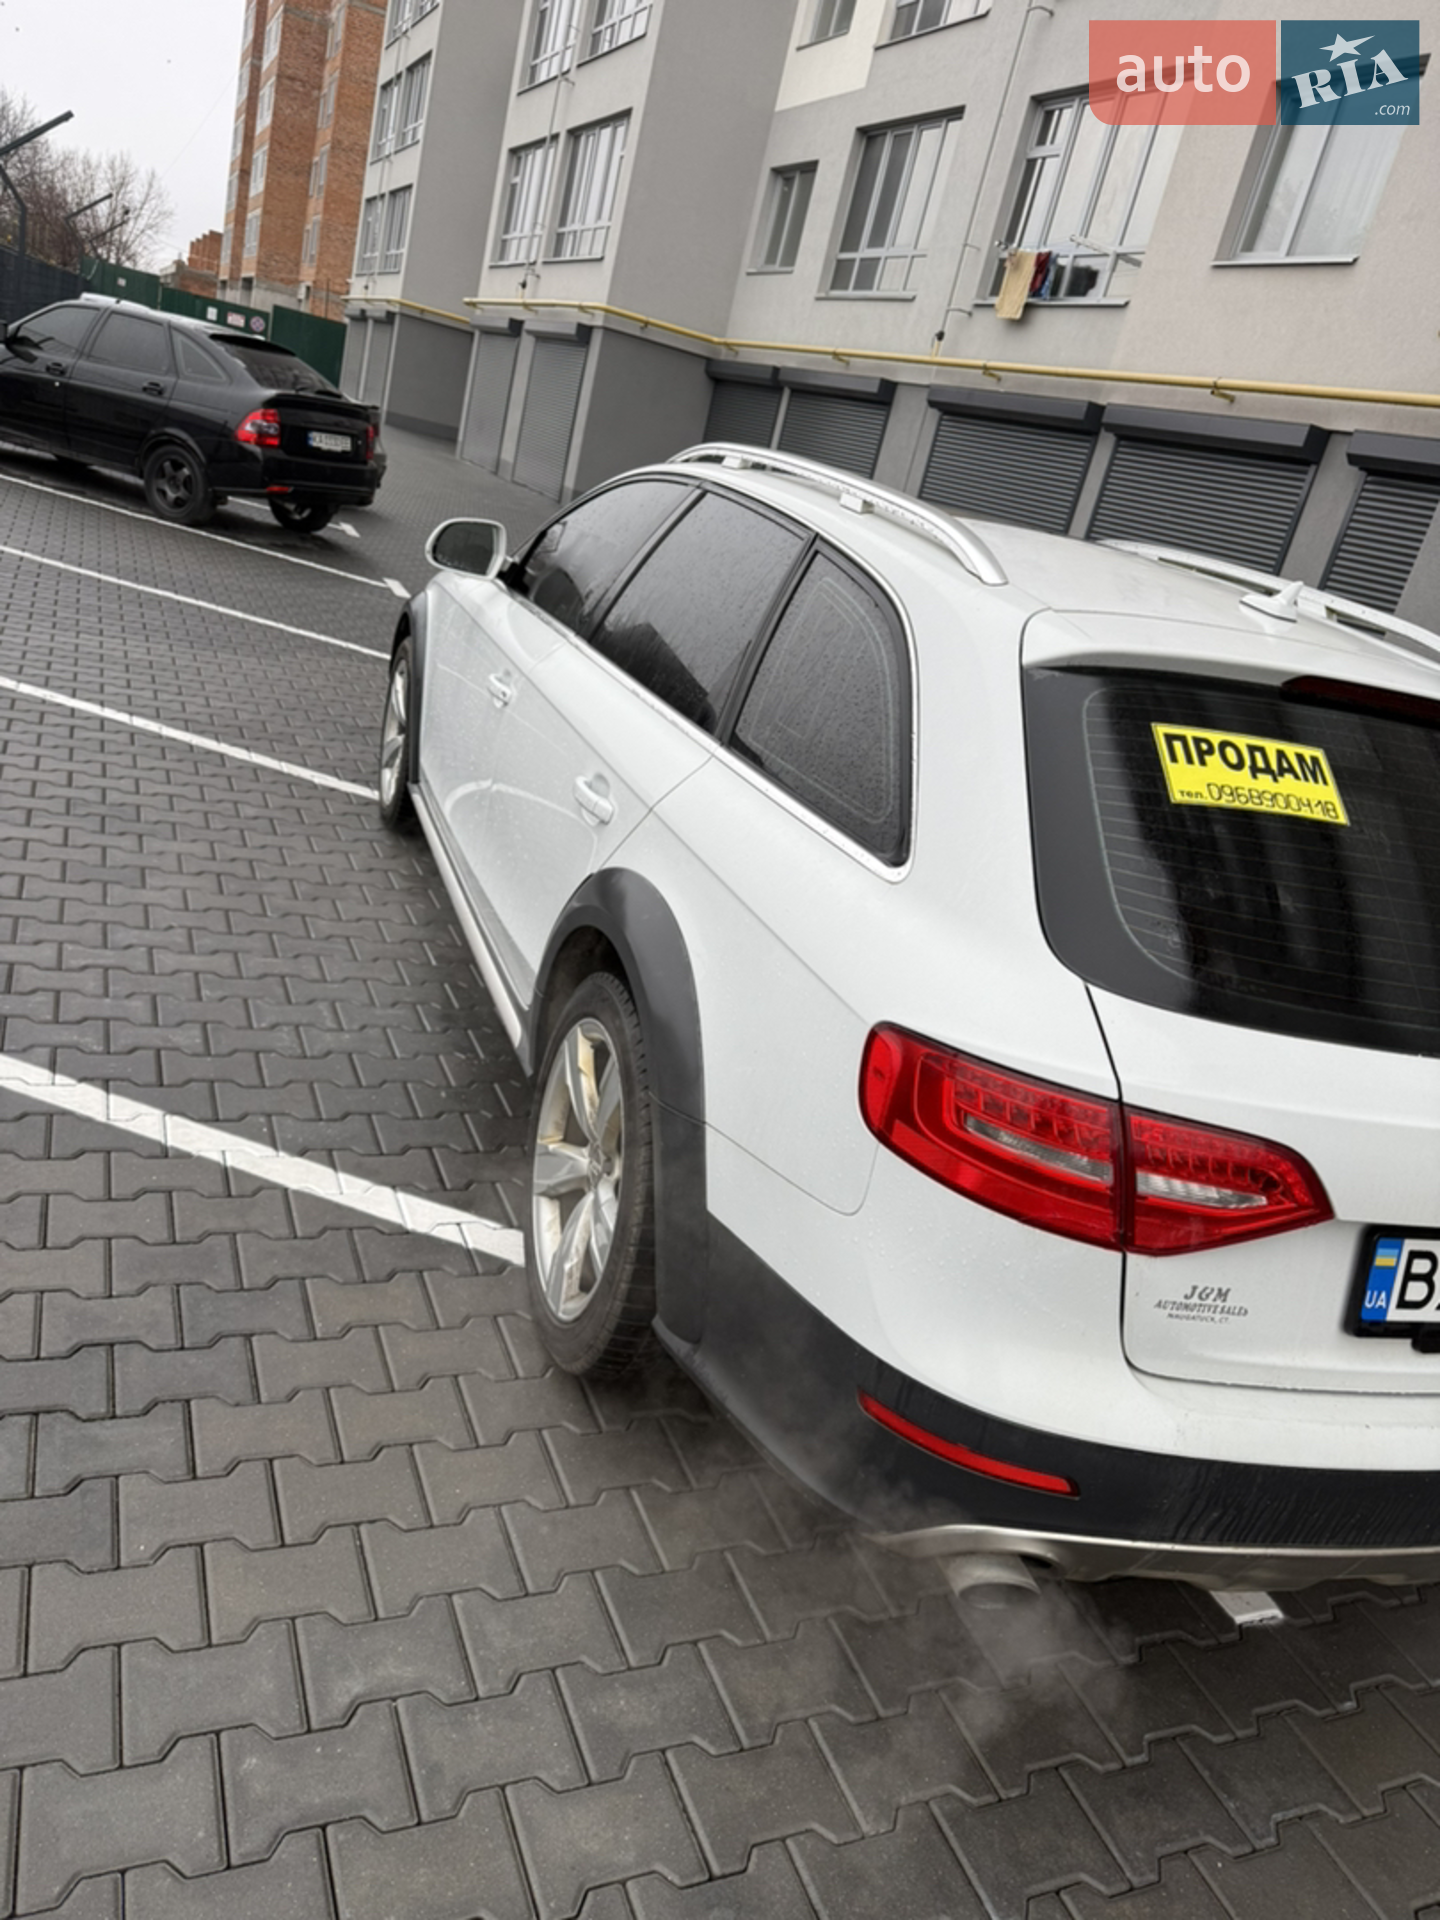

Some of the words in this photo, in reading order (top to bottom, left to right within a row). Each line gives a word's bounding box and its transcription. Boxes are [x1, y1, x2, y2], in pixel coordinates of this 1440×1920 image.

[1163, 733, 1328, 786] ПРОДАМ
[1364, 1290, 1387, 1309] UA
[1395, 1249, 1440, 1310] B
